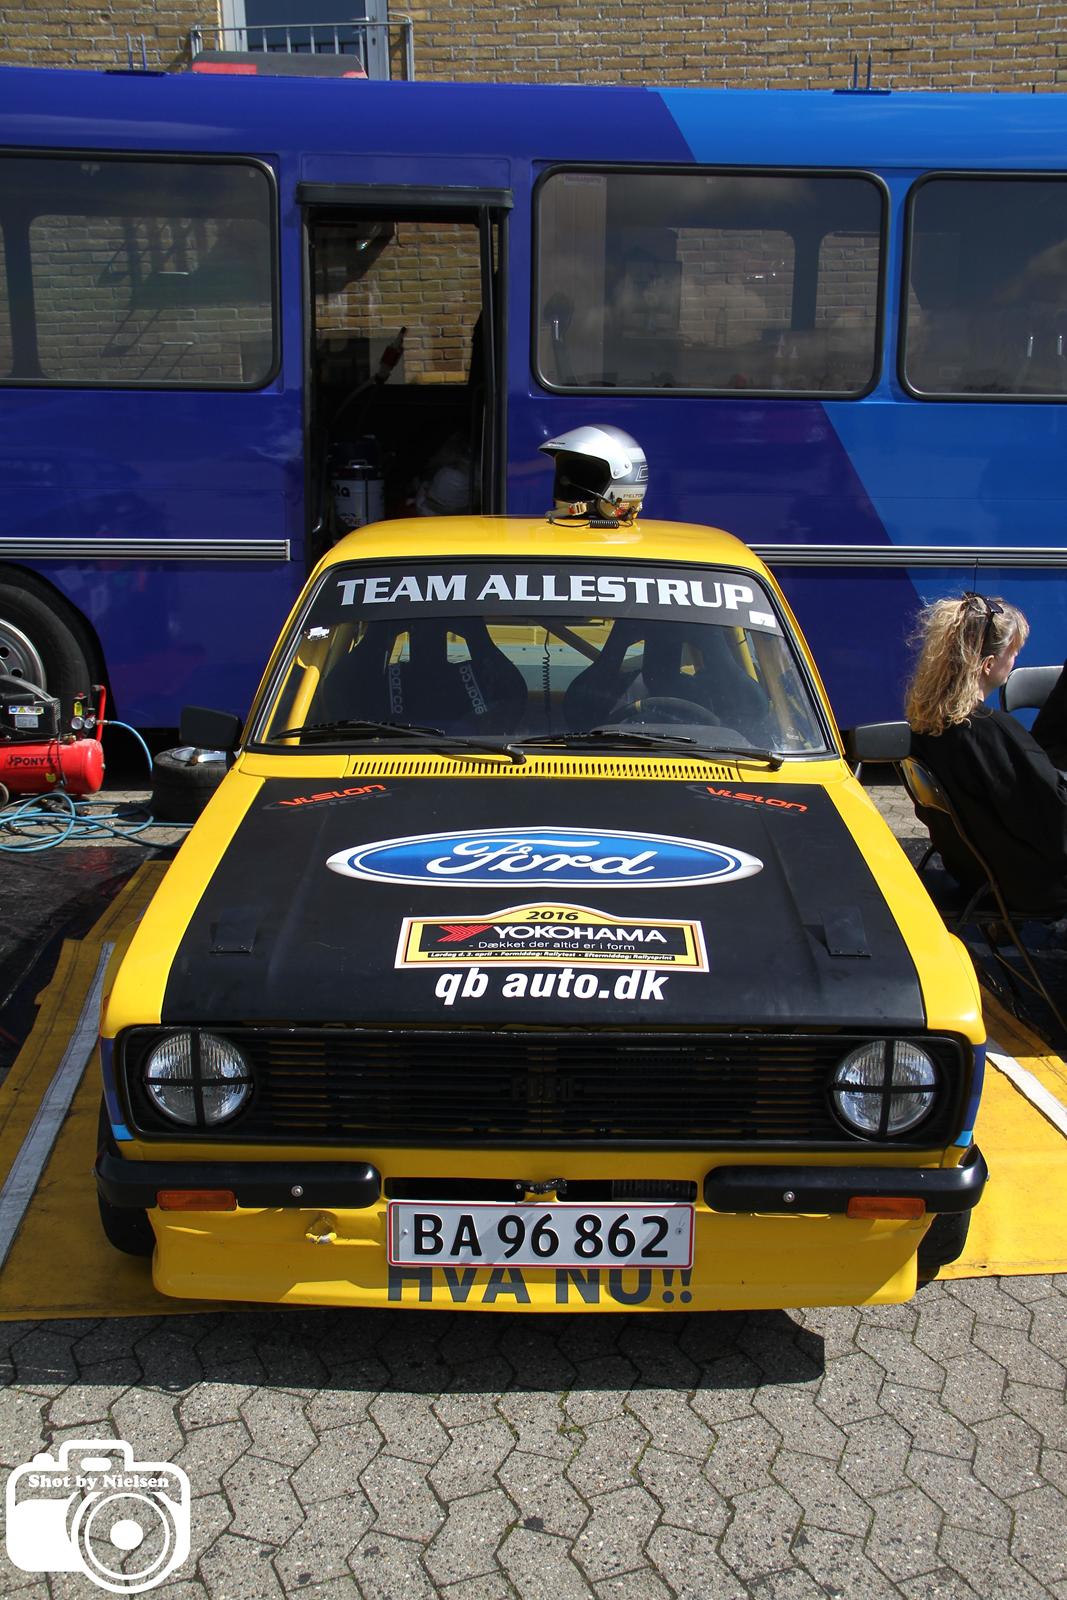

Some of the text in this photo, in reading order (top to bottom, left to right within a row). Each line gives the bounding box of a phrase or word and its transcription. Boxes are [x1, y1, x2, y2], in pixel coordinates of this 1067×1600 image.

[337, 574, 754, 610] TEAM ALLESTRUP
[425, 837, 658, 876] Ford
[493, 925, 668, 943] YOKOHAMA
[525, 910, 579, 921] 2016
[478, 941, 525, 949] Dækket
[528, 940, 550, 949] der
[553, 941, 579, 949] altid
[606, 943, 636, 951] form
[434, 967, 670, 1006] qb auto.dk
[413, 1212, 669, 1259] BA 96 862
[387, 1267, 693, 1306] HVA NU!!
